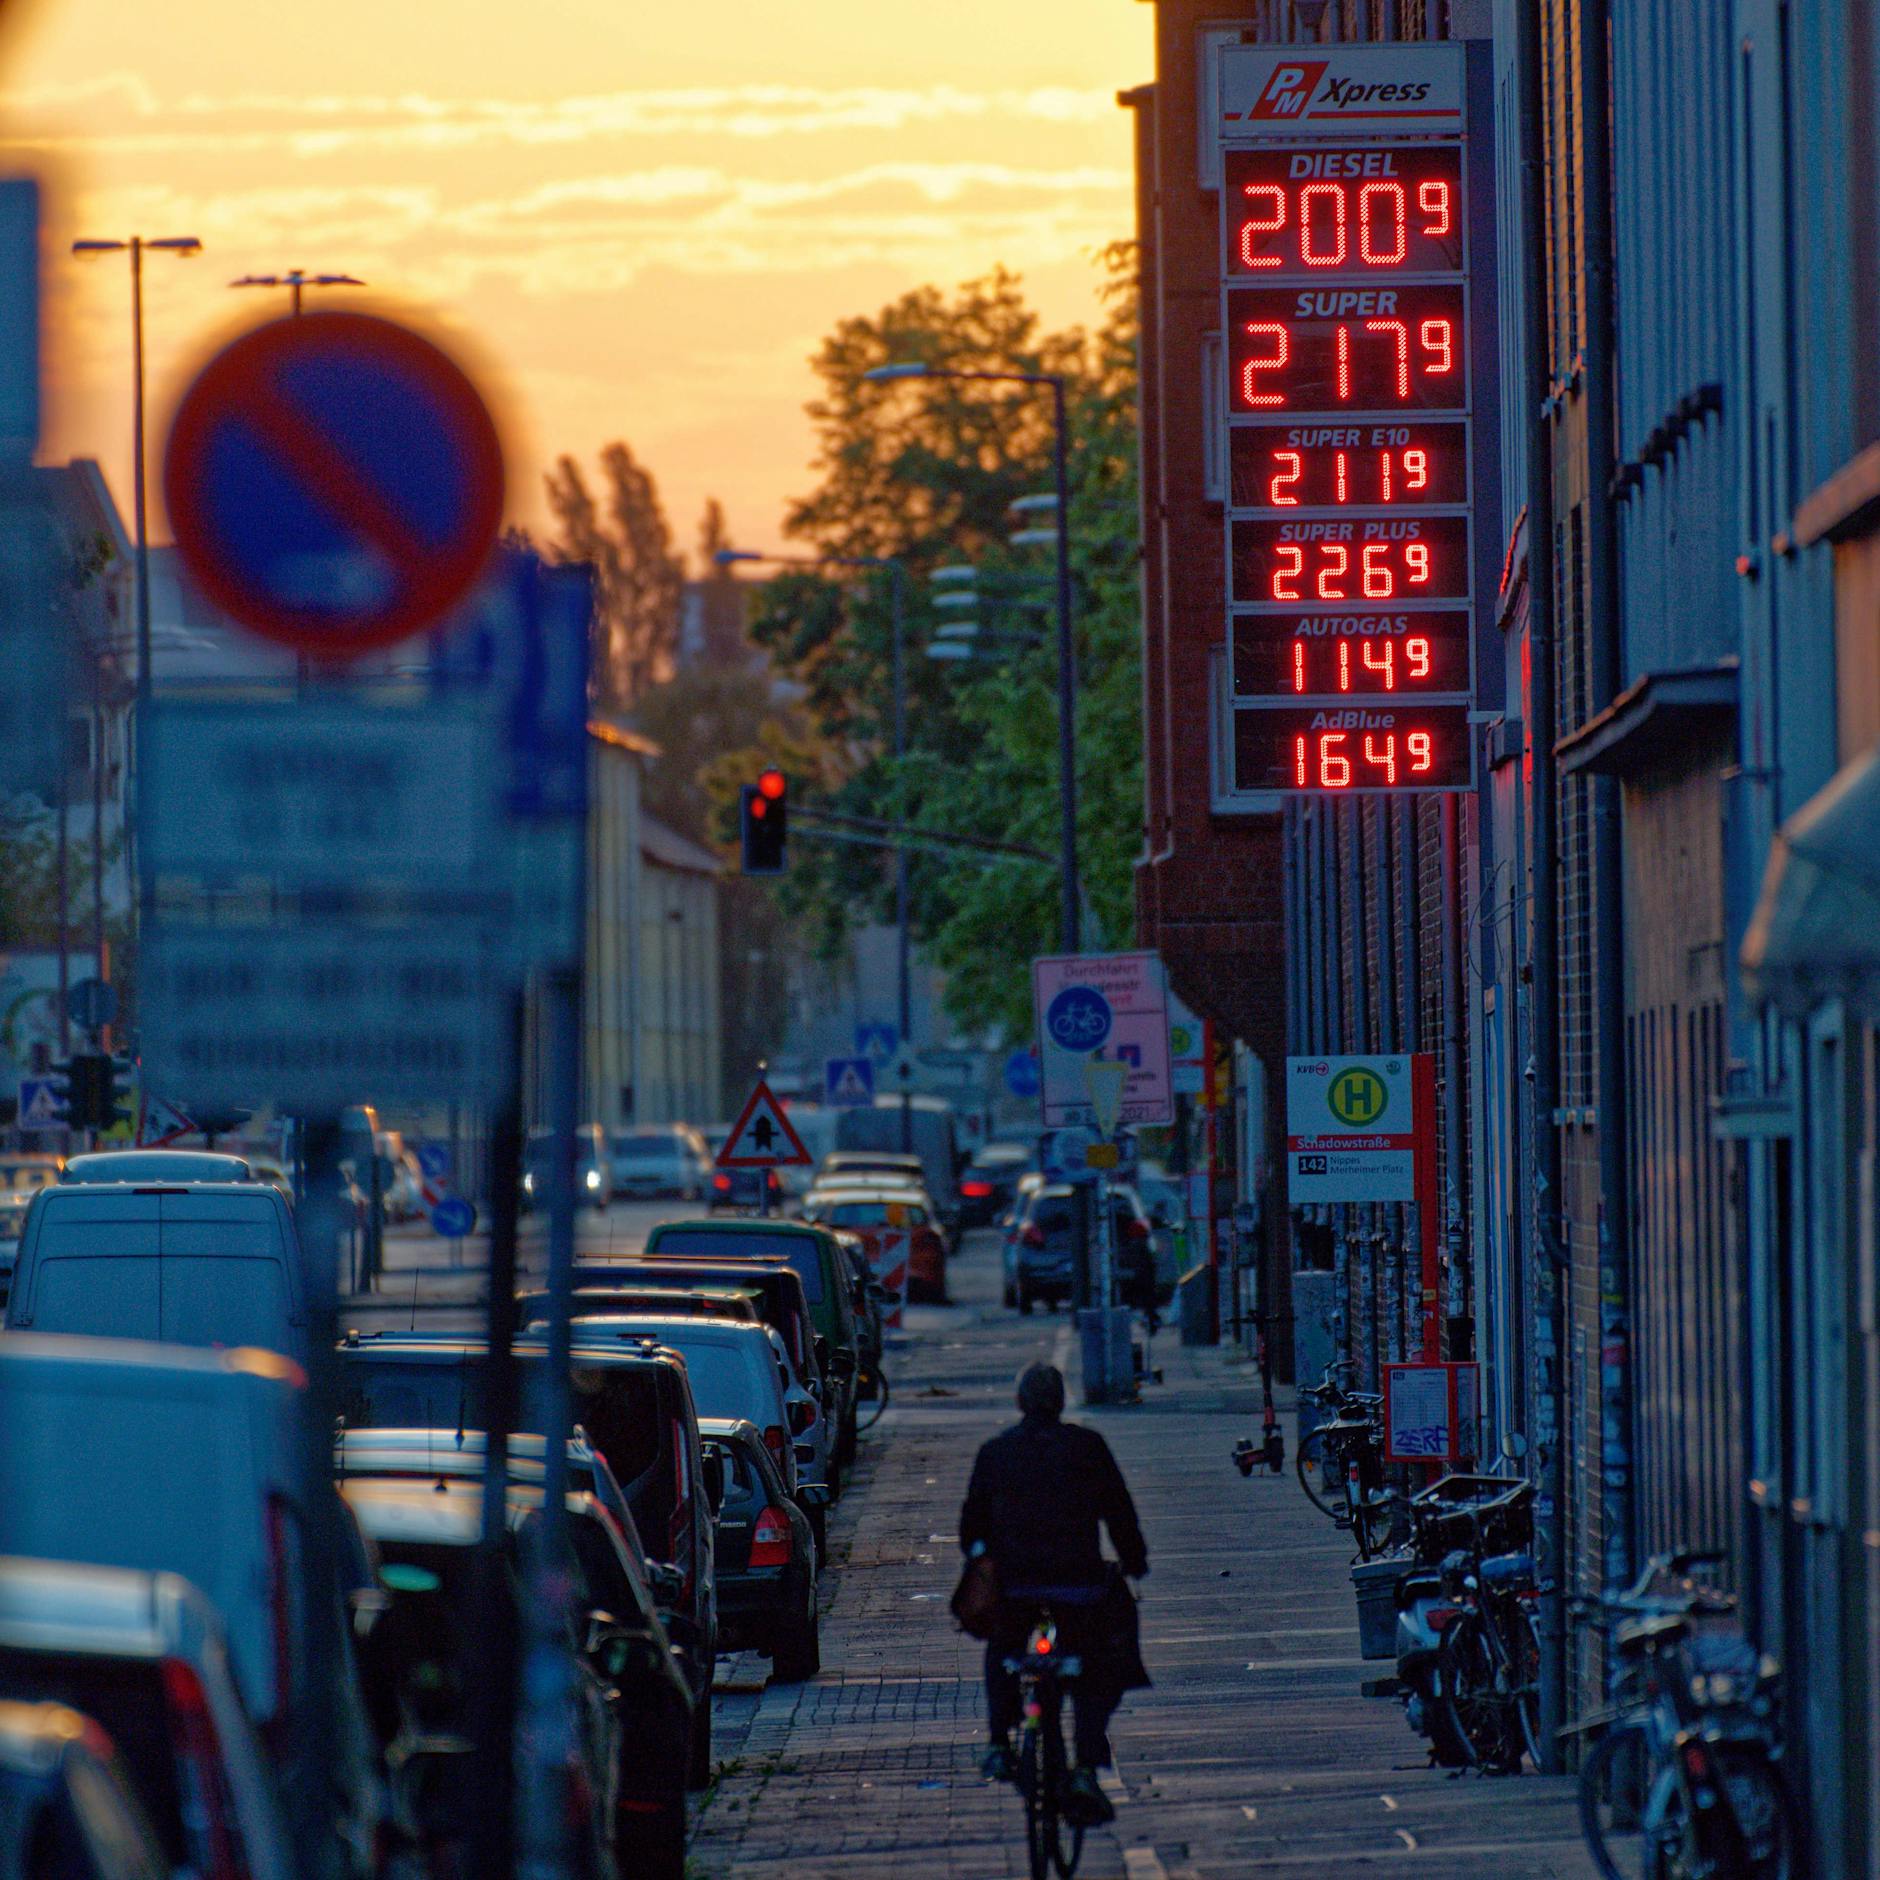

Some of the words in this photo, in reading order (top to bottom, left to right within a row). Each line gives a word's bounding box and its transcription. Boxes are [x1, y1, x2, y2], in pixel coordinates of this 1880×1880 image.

[1318, 77, 1431, 108] Xpress
[1289, 153, 1399, 179] DIESEL
[1241, 181, 1449, 268] 2009
[1295, 291, 1398, 317] SUPER
[1243, 320, 1452, 406] 2179
[1287, 429, 1360, 449] SUPER
[1371, 427, 1411, 446] E10
[1270, 449, 1427, 505] 2119
[1279, 523, 1354, 543] SUPER
[1364, 521, 1421, 540] PLUS
[1272, 543, 1429, 600] 2269
[1295, 616, 1408, 637] AUTOGAS
[1295, 637, 1429, 692] 1149
[1311, 710, 1396, 731] AdBlue
[1296, 732, 1431, 787] 1649
[1344, 1078, 1373, 1115] H
[1297, 1136, 1391, 1150] Schadowstraße
[1300, 1158, 1326, 1171] 142
